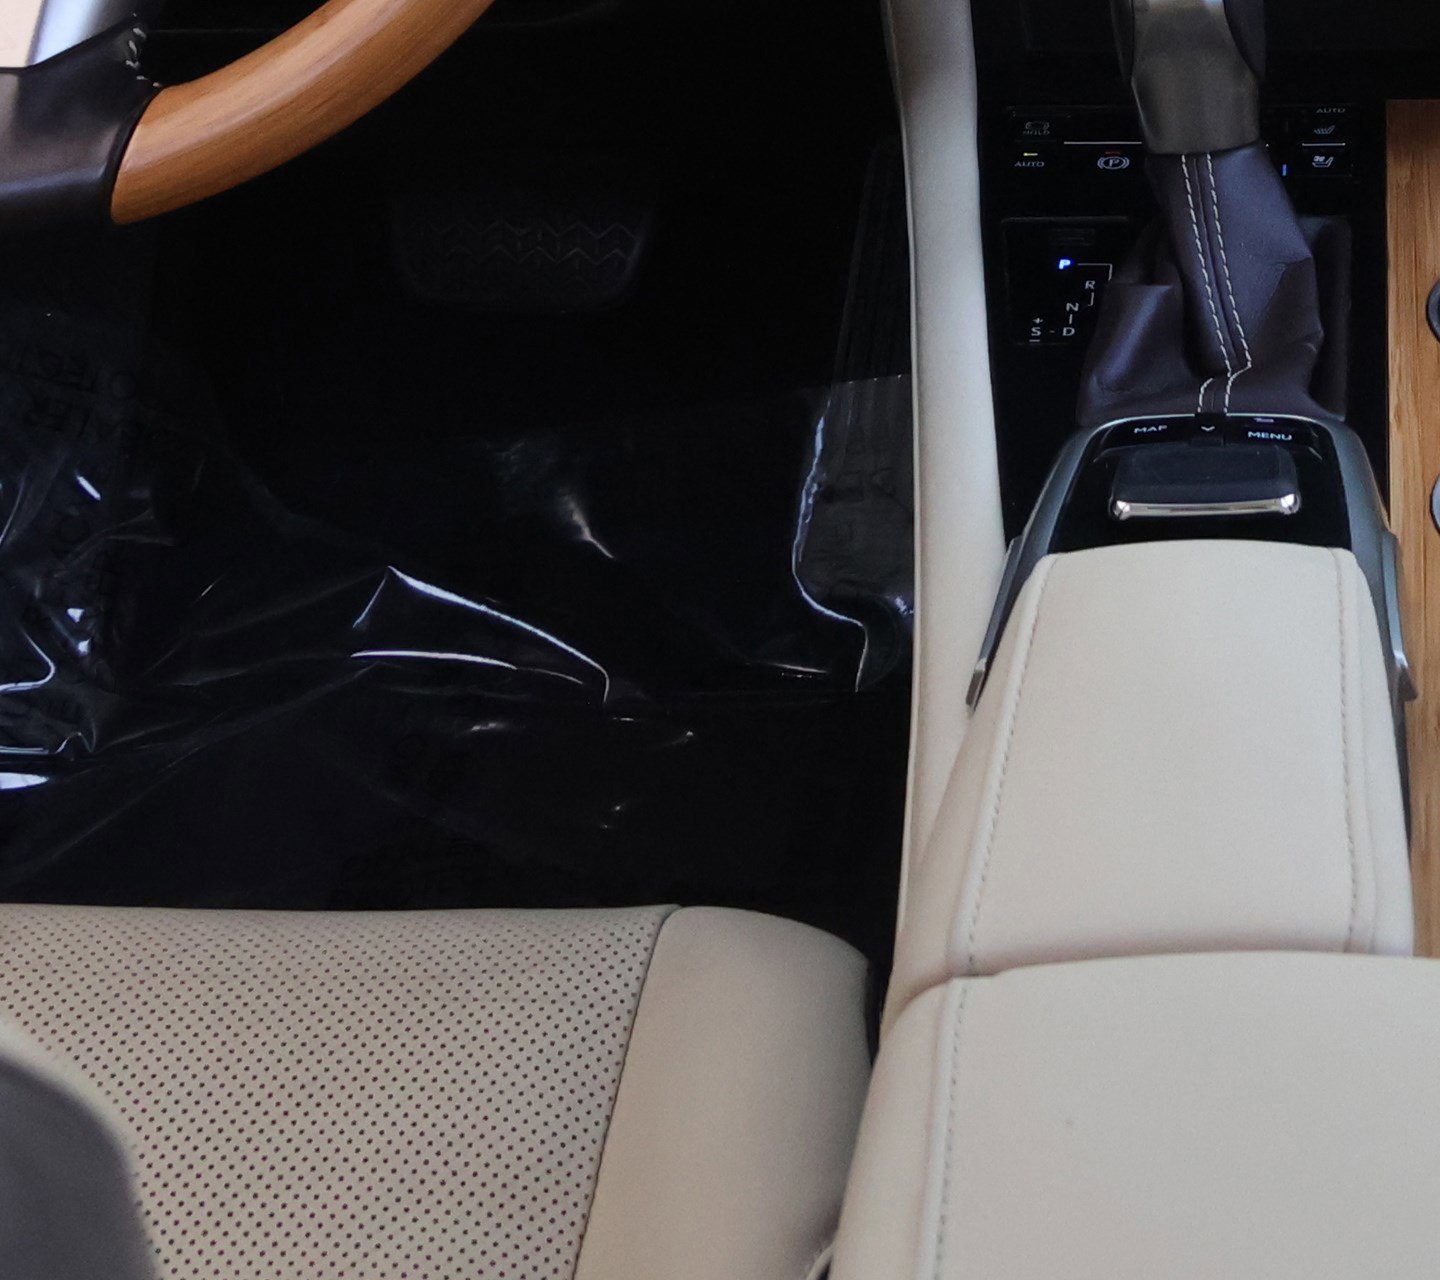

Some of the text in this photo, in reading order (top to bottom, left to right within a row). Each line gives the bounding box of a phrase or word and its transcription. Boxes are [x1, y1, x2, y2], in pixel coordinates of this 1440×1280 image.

[1014, 160, 1045, 168] AUTO
[1058, 259, 1071, 270] P
[1085, 280, 1096, 290] R
[1066, 302, 1079, 312] N
[1031, 327, 1041, 337] S
[1062, 327, 1075, 337] D
[1247, 431, 1292, 441] MENU
